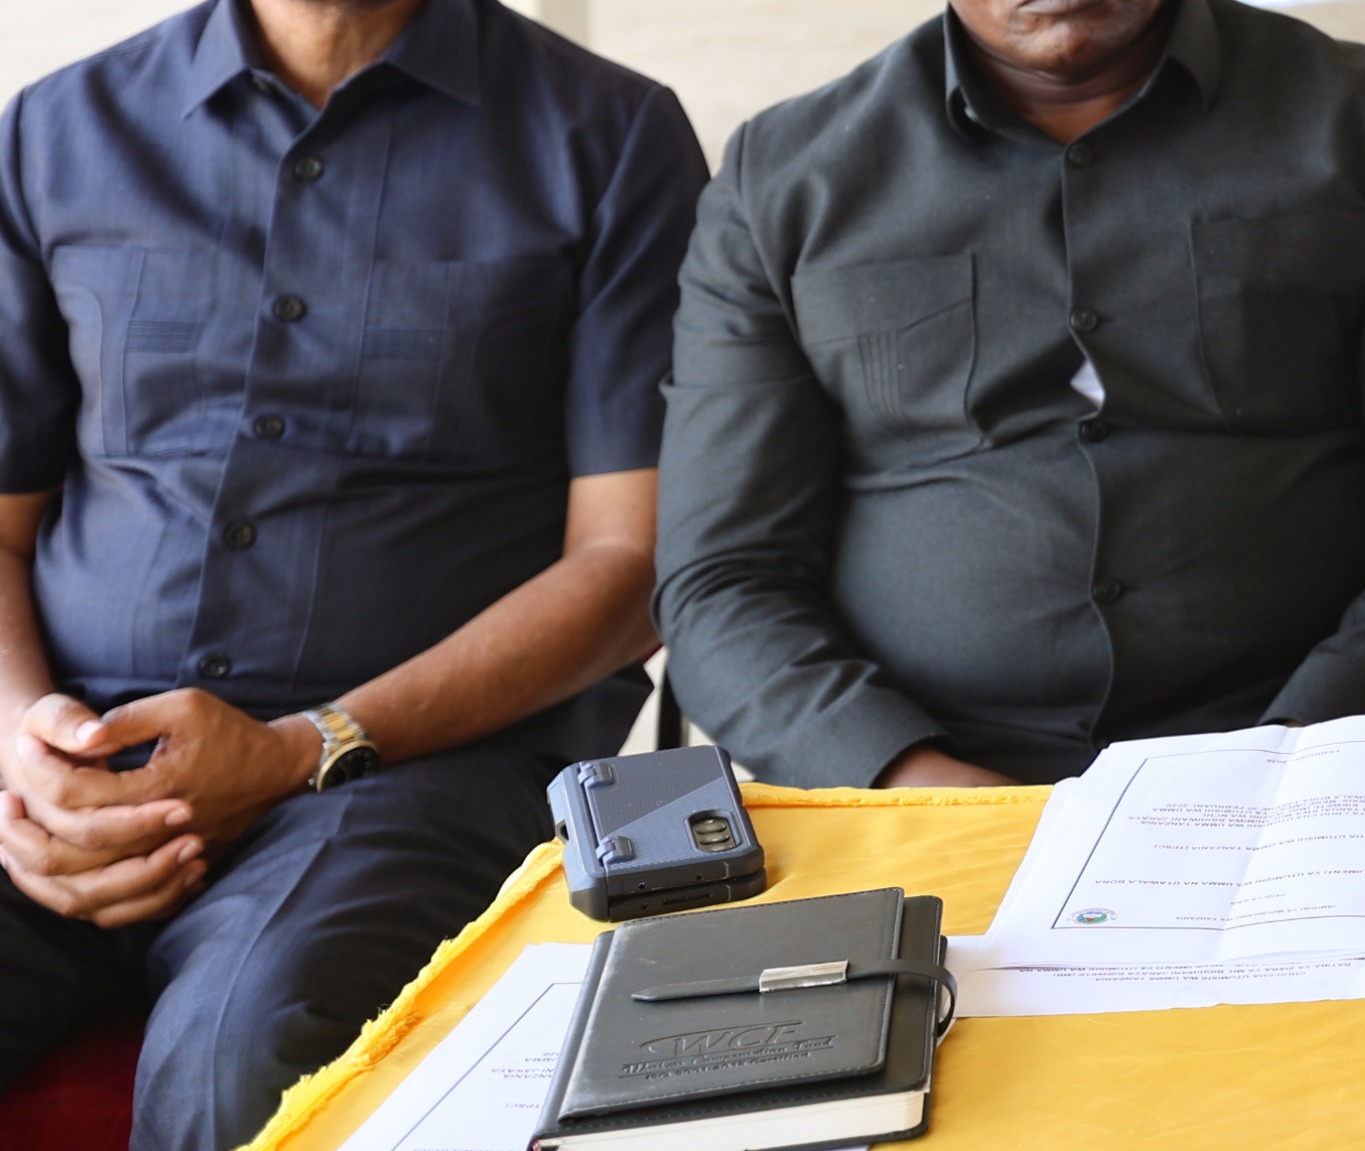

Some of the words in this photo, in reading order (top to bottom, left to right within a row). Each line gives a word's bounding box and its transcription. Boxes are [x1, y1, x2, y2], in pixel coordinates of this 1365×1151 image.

[1246, 842, 1275, 851] UMMA
[1255, 873, 1304, 883] UTUMISHI
[672, 1022, 805, 1056] WCF
[793, 1037, 835, 1050] Fund
